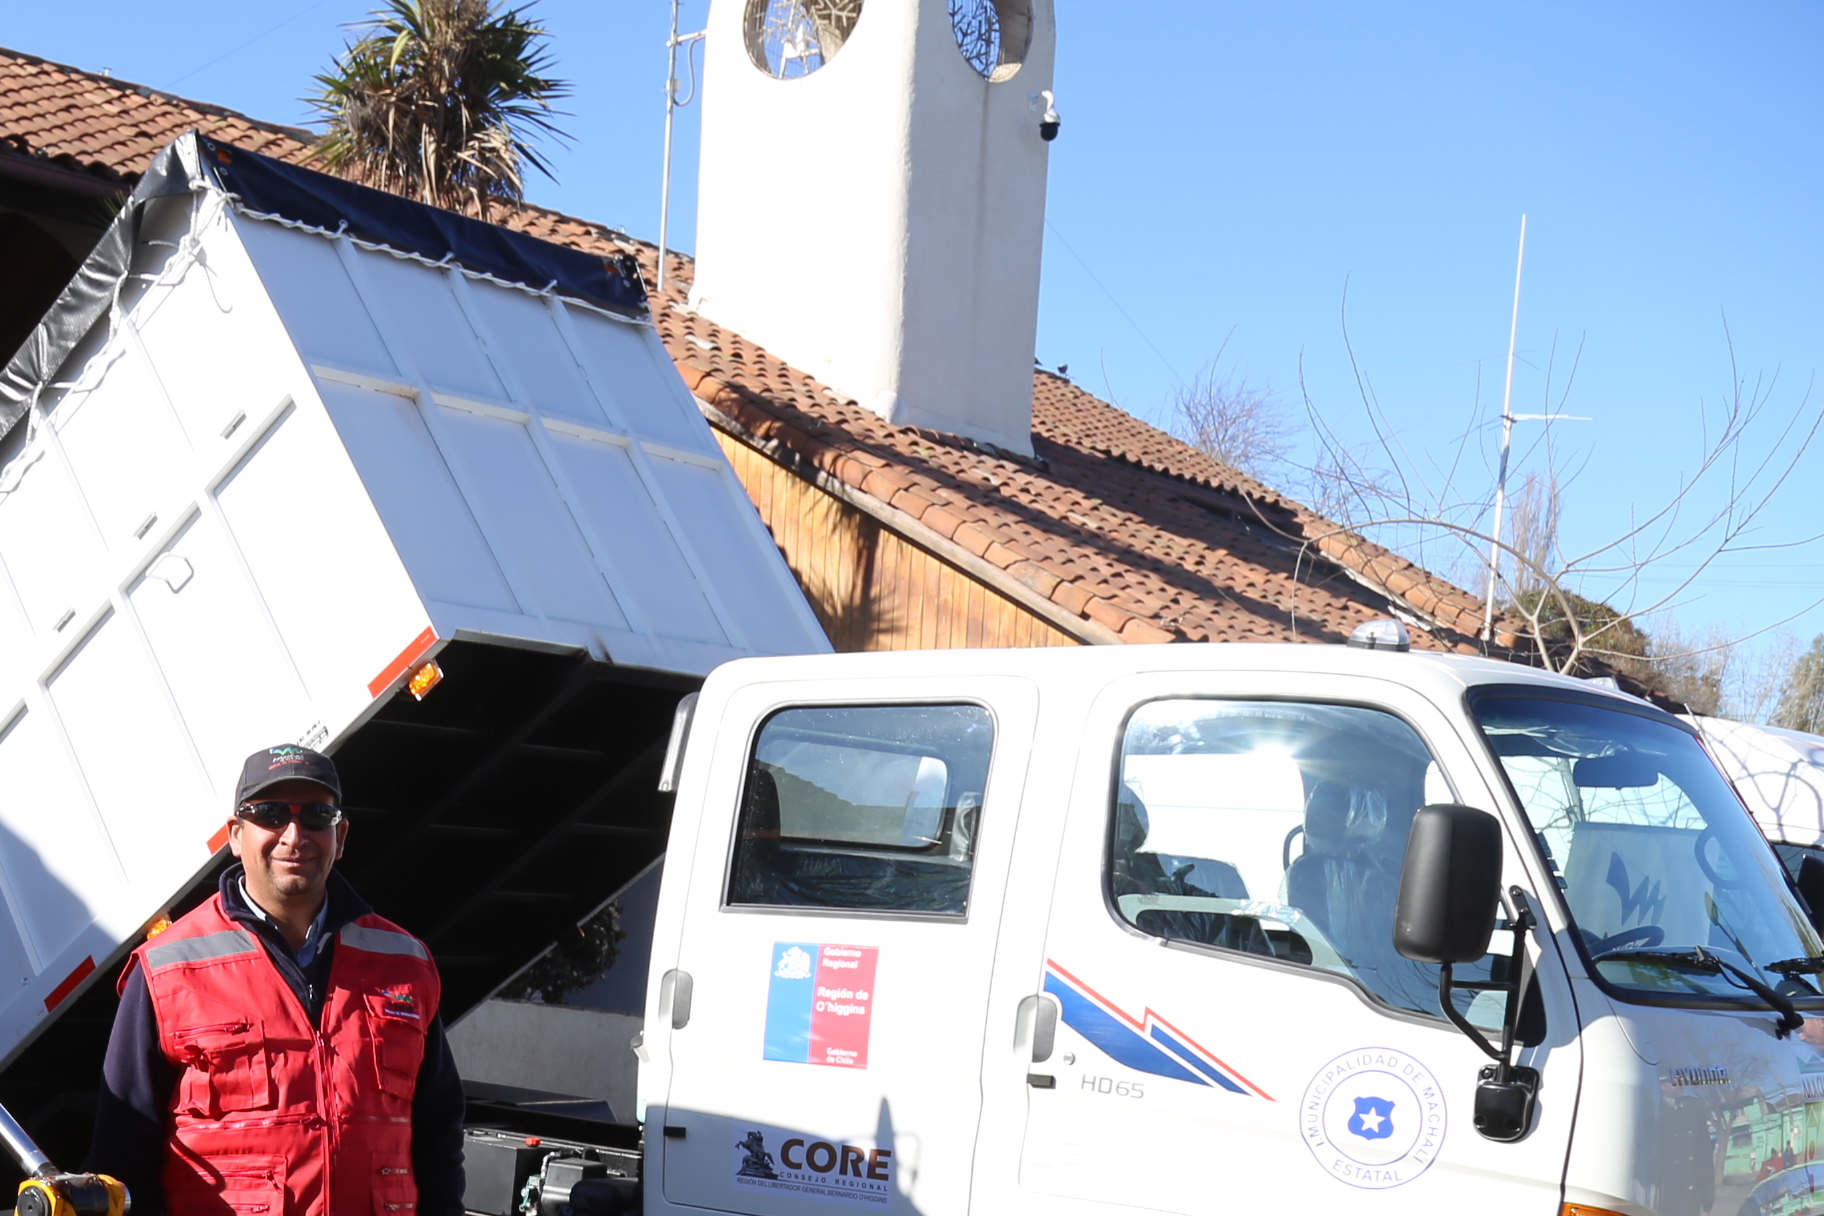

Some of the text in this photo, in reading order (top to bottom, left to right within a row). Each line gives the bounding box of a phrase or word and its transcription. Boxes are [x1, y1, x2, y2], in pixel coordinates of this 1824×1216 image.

[824, 947, 862, 958] Gobierno
[822, 958, 858, 970] Regional
[817, 986, 869, 1001] Región de
[826, 1047, 858, 1057] Gobierno
[826, 1056, 854, 1065] de Chile
[1402, 1063, 1425, 1084] DE
[1081, 1074, 1145, 1099] HD65
[780, 1138, 892, 1181] CORE
[1332, 1159, 1404, 1182] ESTATAL
[757, 1179, 768, 1188] DEL
[768, 1181, 801, 1192] LIBERTADOR
[801, 1185, 827, 1196] GENERAL
[827, 1189, 858, 1200] BERNARDO
[858, 1193, 888, 1204] O'HIGGINS
[779, 1171, 888, 1192] CONSEJO REGIONAL
